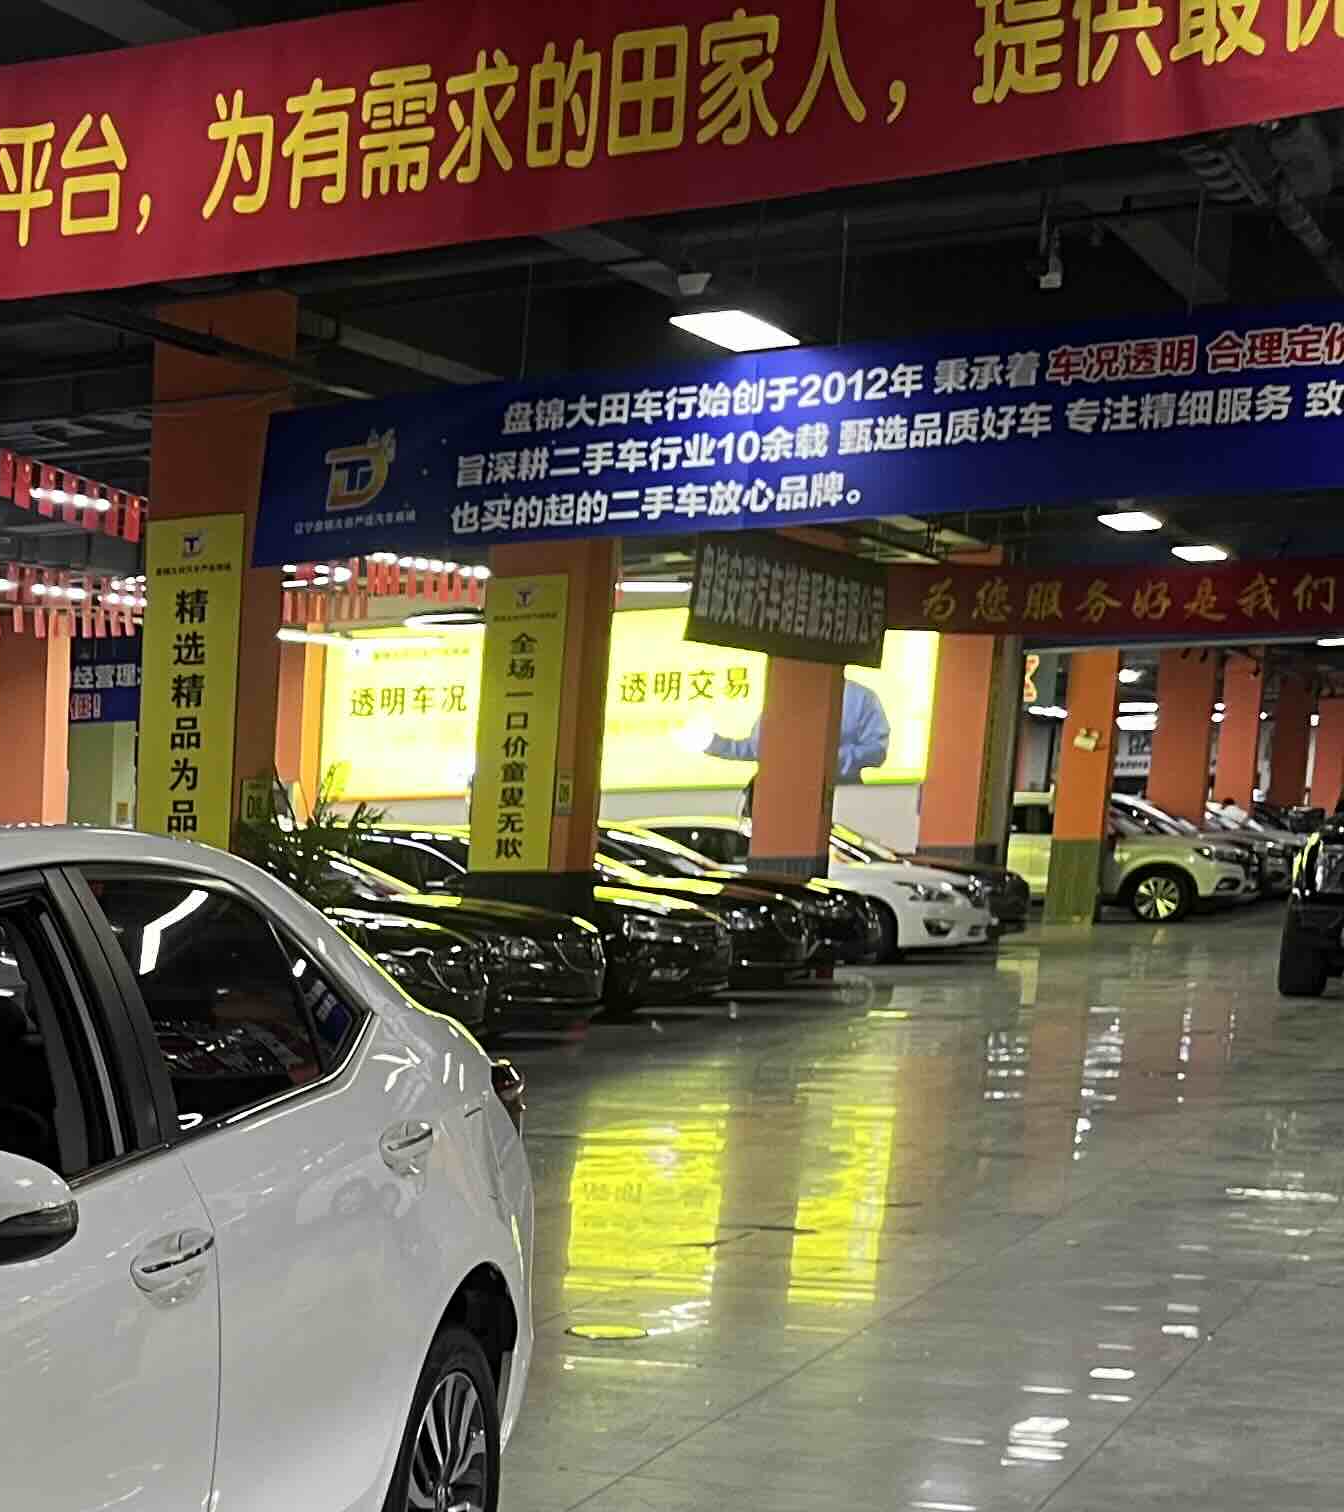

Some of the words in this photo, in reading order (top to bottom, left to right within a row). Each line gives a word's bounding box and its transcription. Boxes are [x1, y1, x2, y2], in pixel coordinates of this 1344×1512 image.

[501, 364, 924, 435] 盘锦大田车行始创于2012年
[933, 351, 1041, 393] 秉承着
[1045, 335, 1198, 385] 车况透明
[455, 421, 829, 488] 旨深耕二手车行业10余载
[837, 402, 1053, 455] 甄选品质好车
[1064, 383, 1293, 433] 专注精细服务
[449, 471, 863, 535] 也买的起的二手车放心品牌。
[921, 572, 1337, 624] 为您服务好是我们
[72, 663, 141, 690] 经营理
[350, 684, 467, 718] 透明车况
[619, 666, 750, 703] 透明交易
[167, 588, 209, 833] 精选精品为品
[495, 631, 538, 860] 全场一口价童叟无欺
